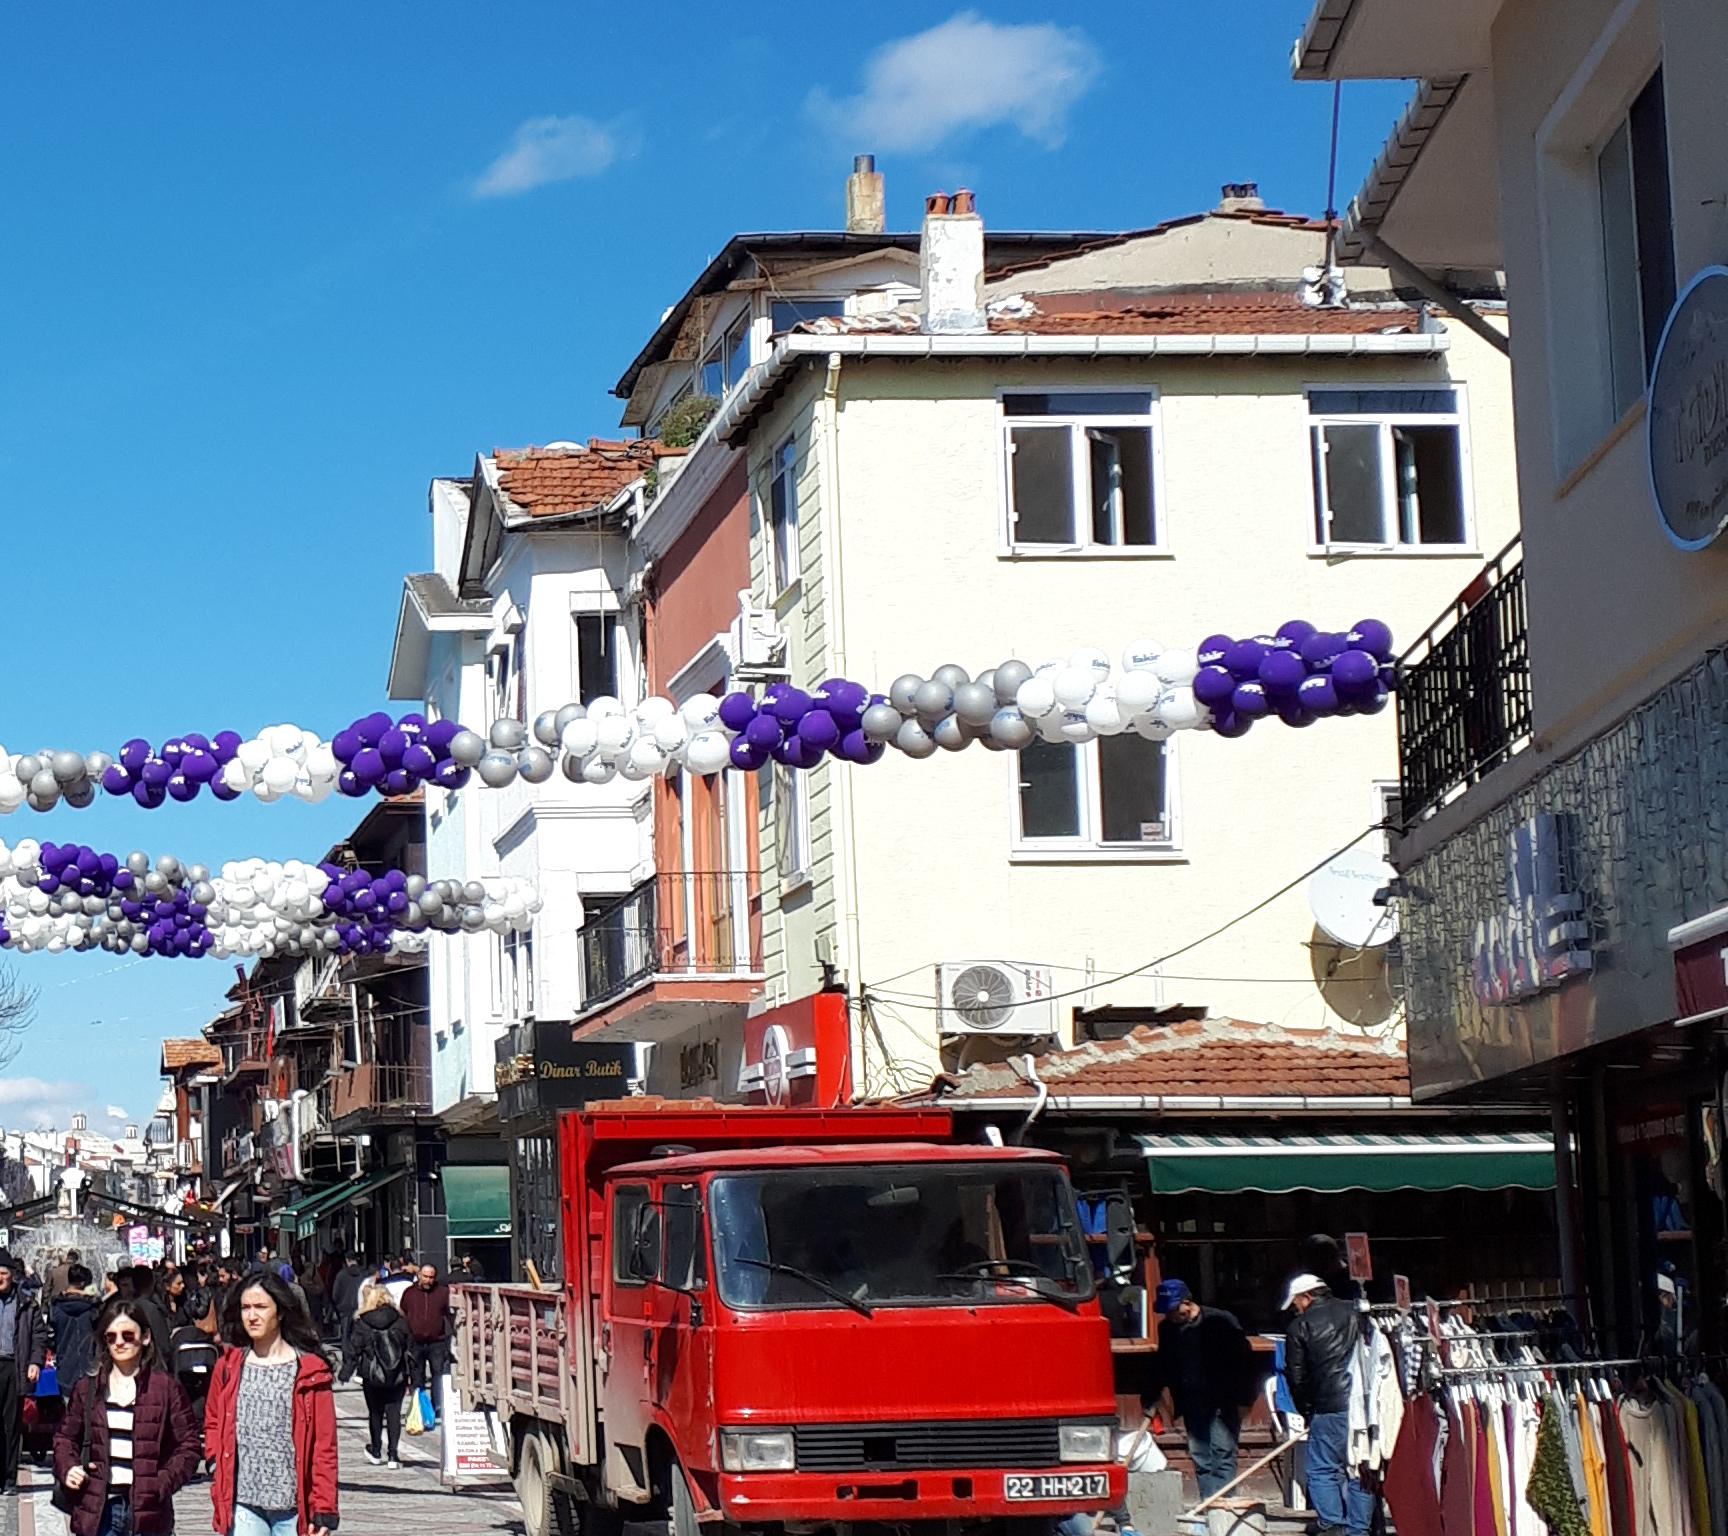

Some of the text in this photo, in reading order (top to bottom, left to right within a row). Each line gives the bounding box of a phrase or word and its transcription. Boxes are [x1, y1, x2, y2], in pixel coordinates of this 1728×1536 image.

[539, 1060, 582, 1080] Dinar
[585, 1058, 623, 1078] Butik
[1008, 1476, 1105, 1497] 22 HH 217
